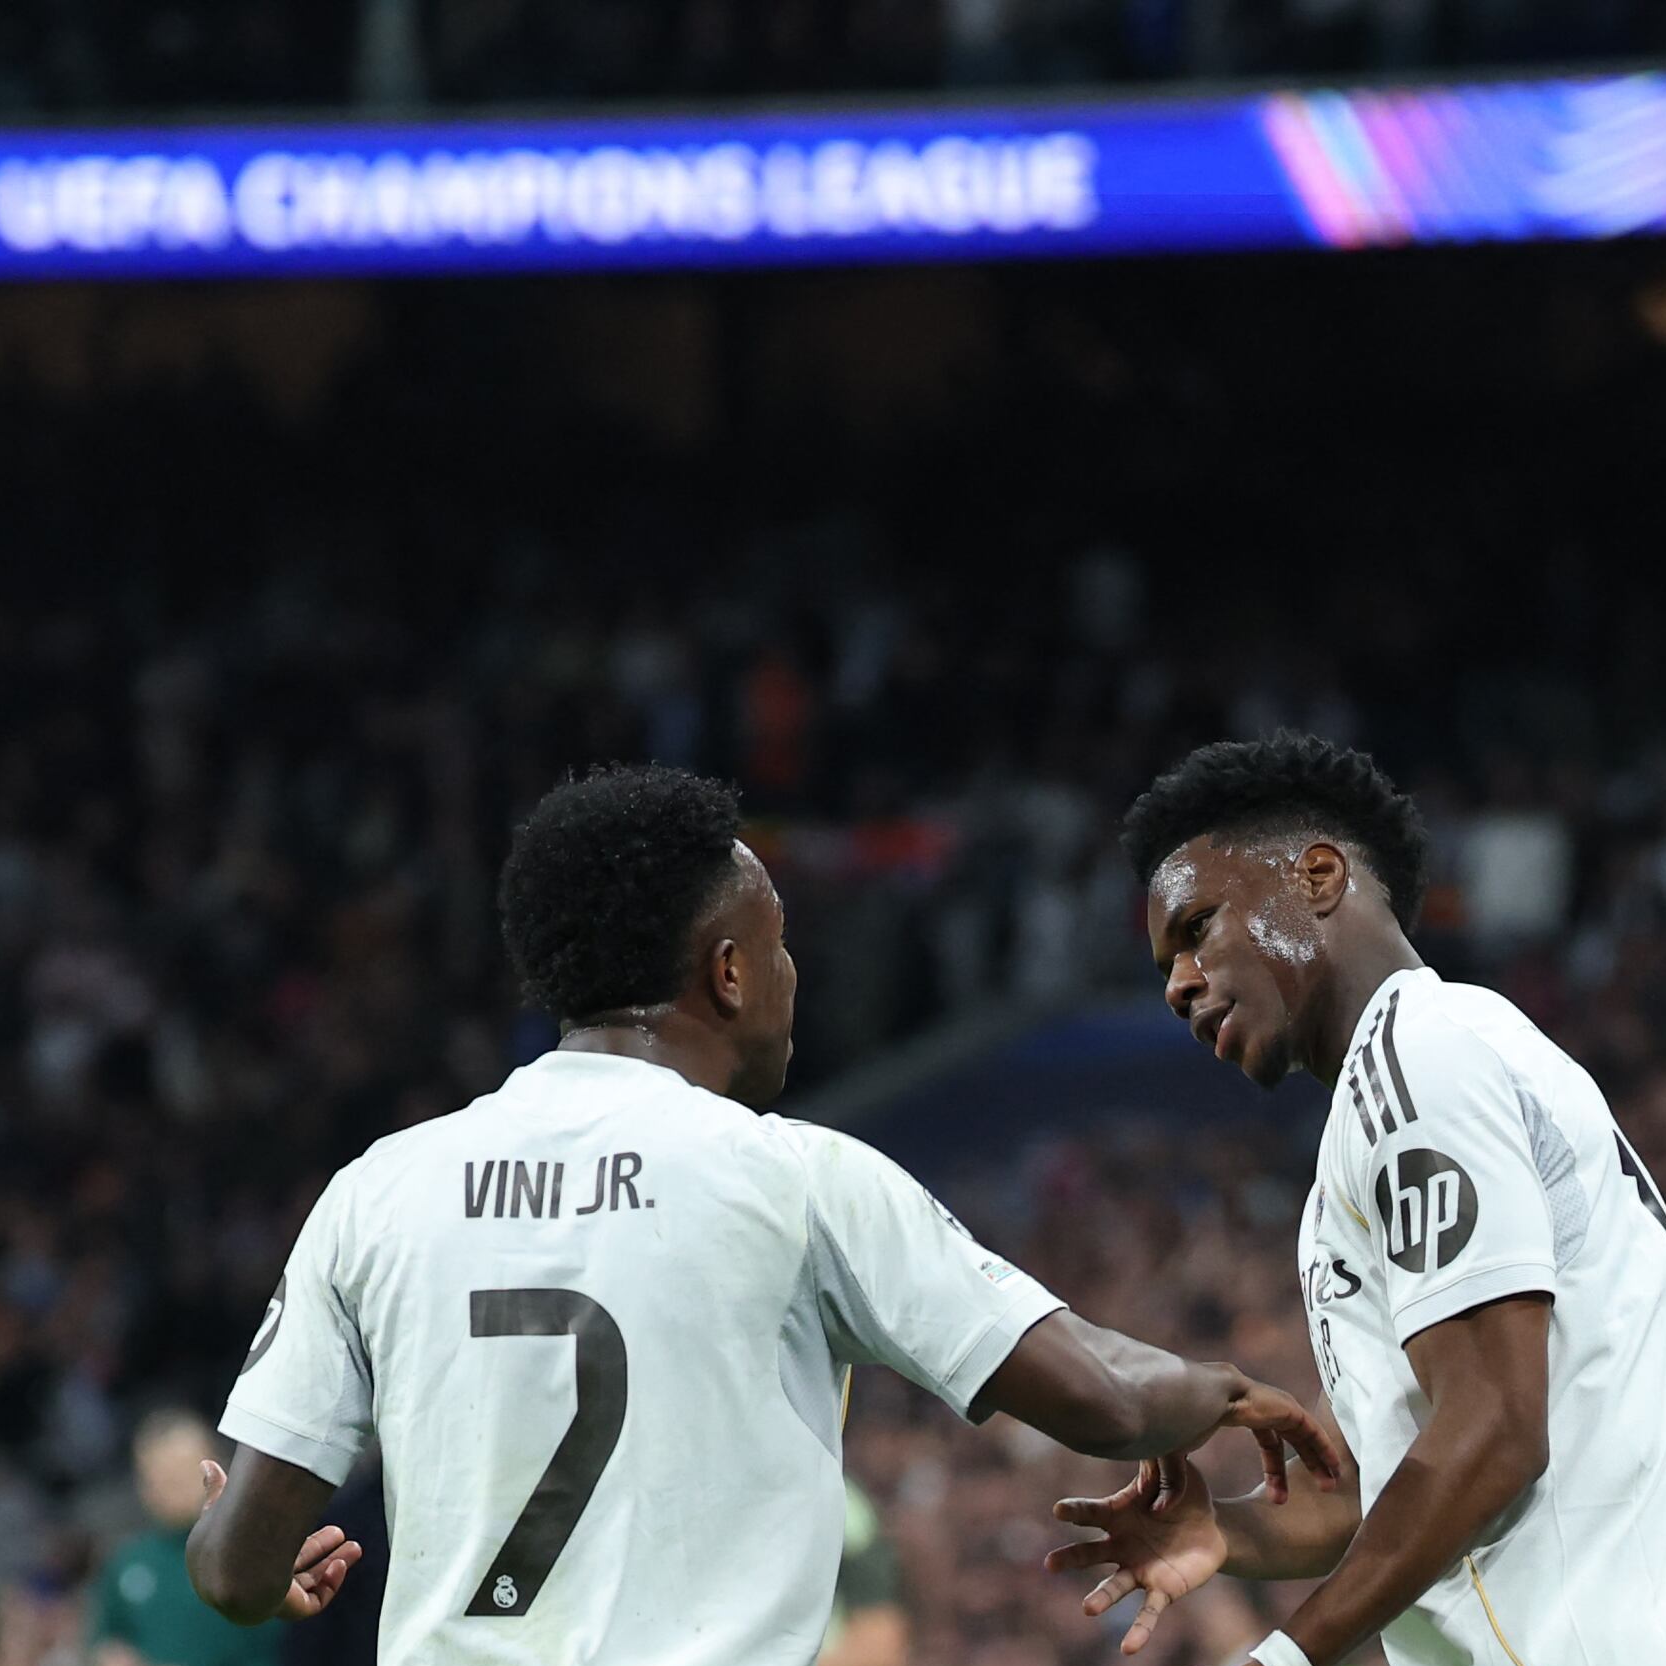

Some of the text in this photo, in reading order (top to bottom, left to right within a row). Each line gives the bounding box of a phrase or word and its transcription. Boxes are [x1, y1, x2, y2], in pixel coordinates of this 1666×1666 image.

[233, 146, 757, 248] CHAMPIONS
[760, 135, 1093, 236] LEAGUE
[464, 1151, 655, 1219] VINI JR.
[1376, 1148, 1479, 1273] hp
[463, 1288, 628, 1617] 7
